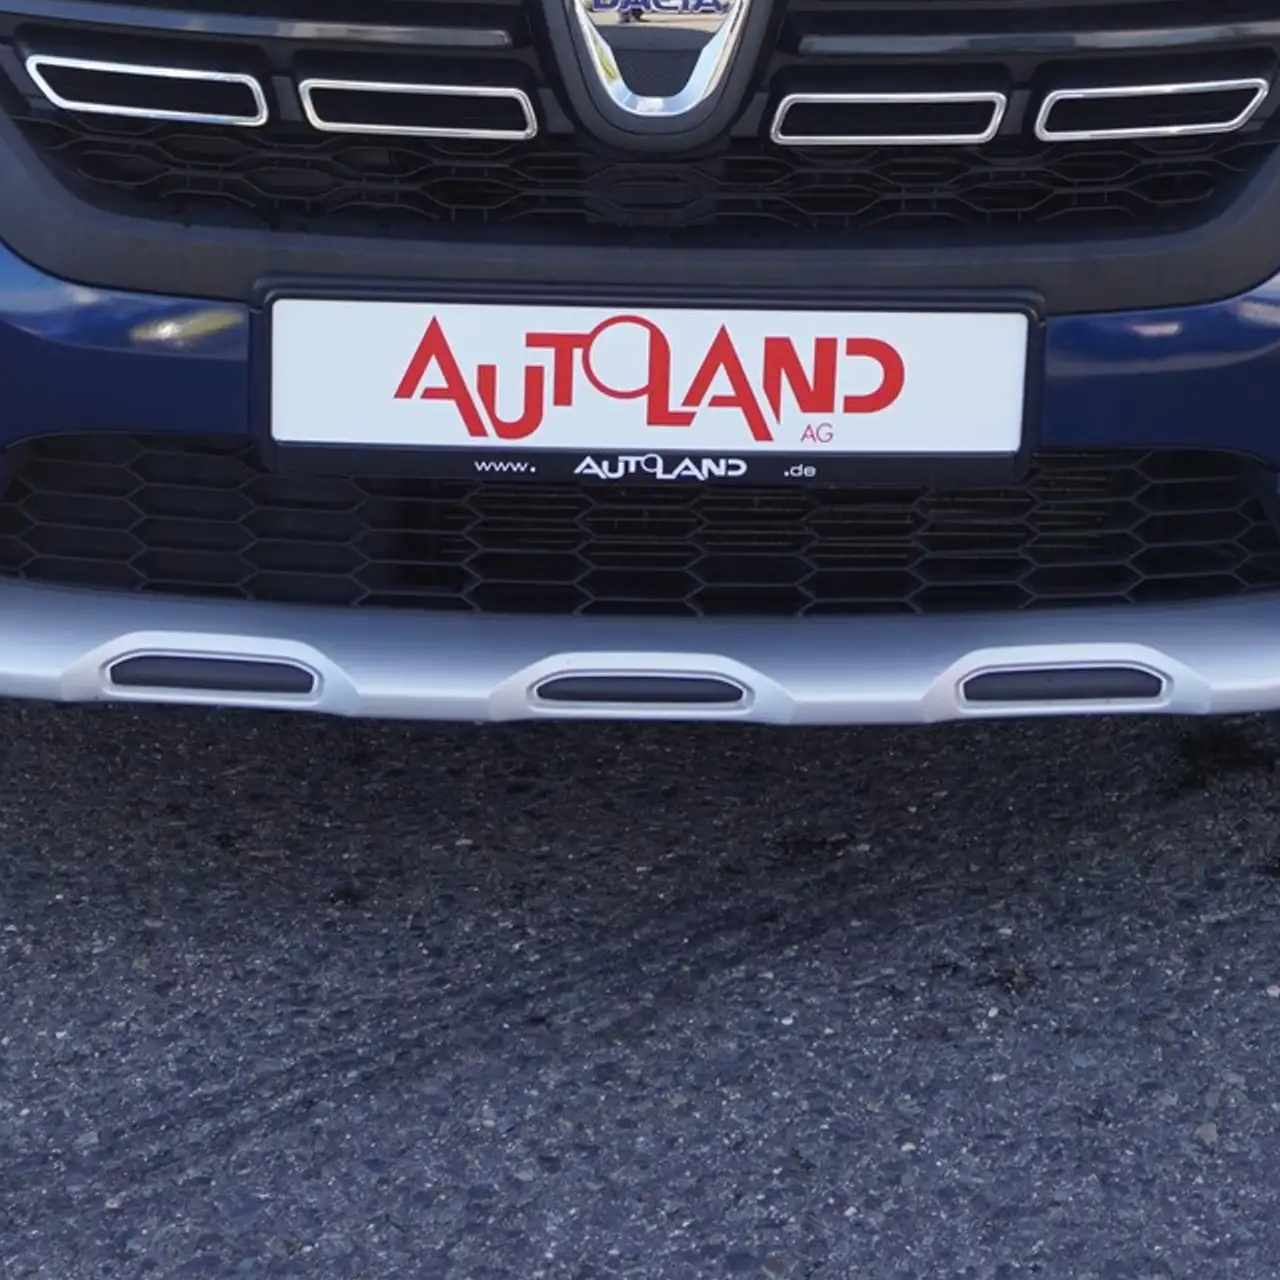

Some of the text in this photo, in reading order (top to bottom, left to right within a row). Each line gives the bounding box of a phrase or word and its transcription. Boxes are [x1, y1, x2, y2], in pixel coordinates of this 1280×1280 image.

[393, 314, 906, 442] AUTOLAND
[801, 423, 834, 443] AG
[474, 461, 536, 472] www.
[783, 464, 817, 477] .de
